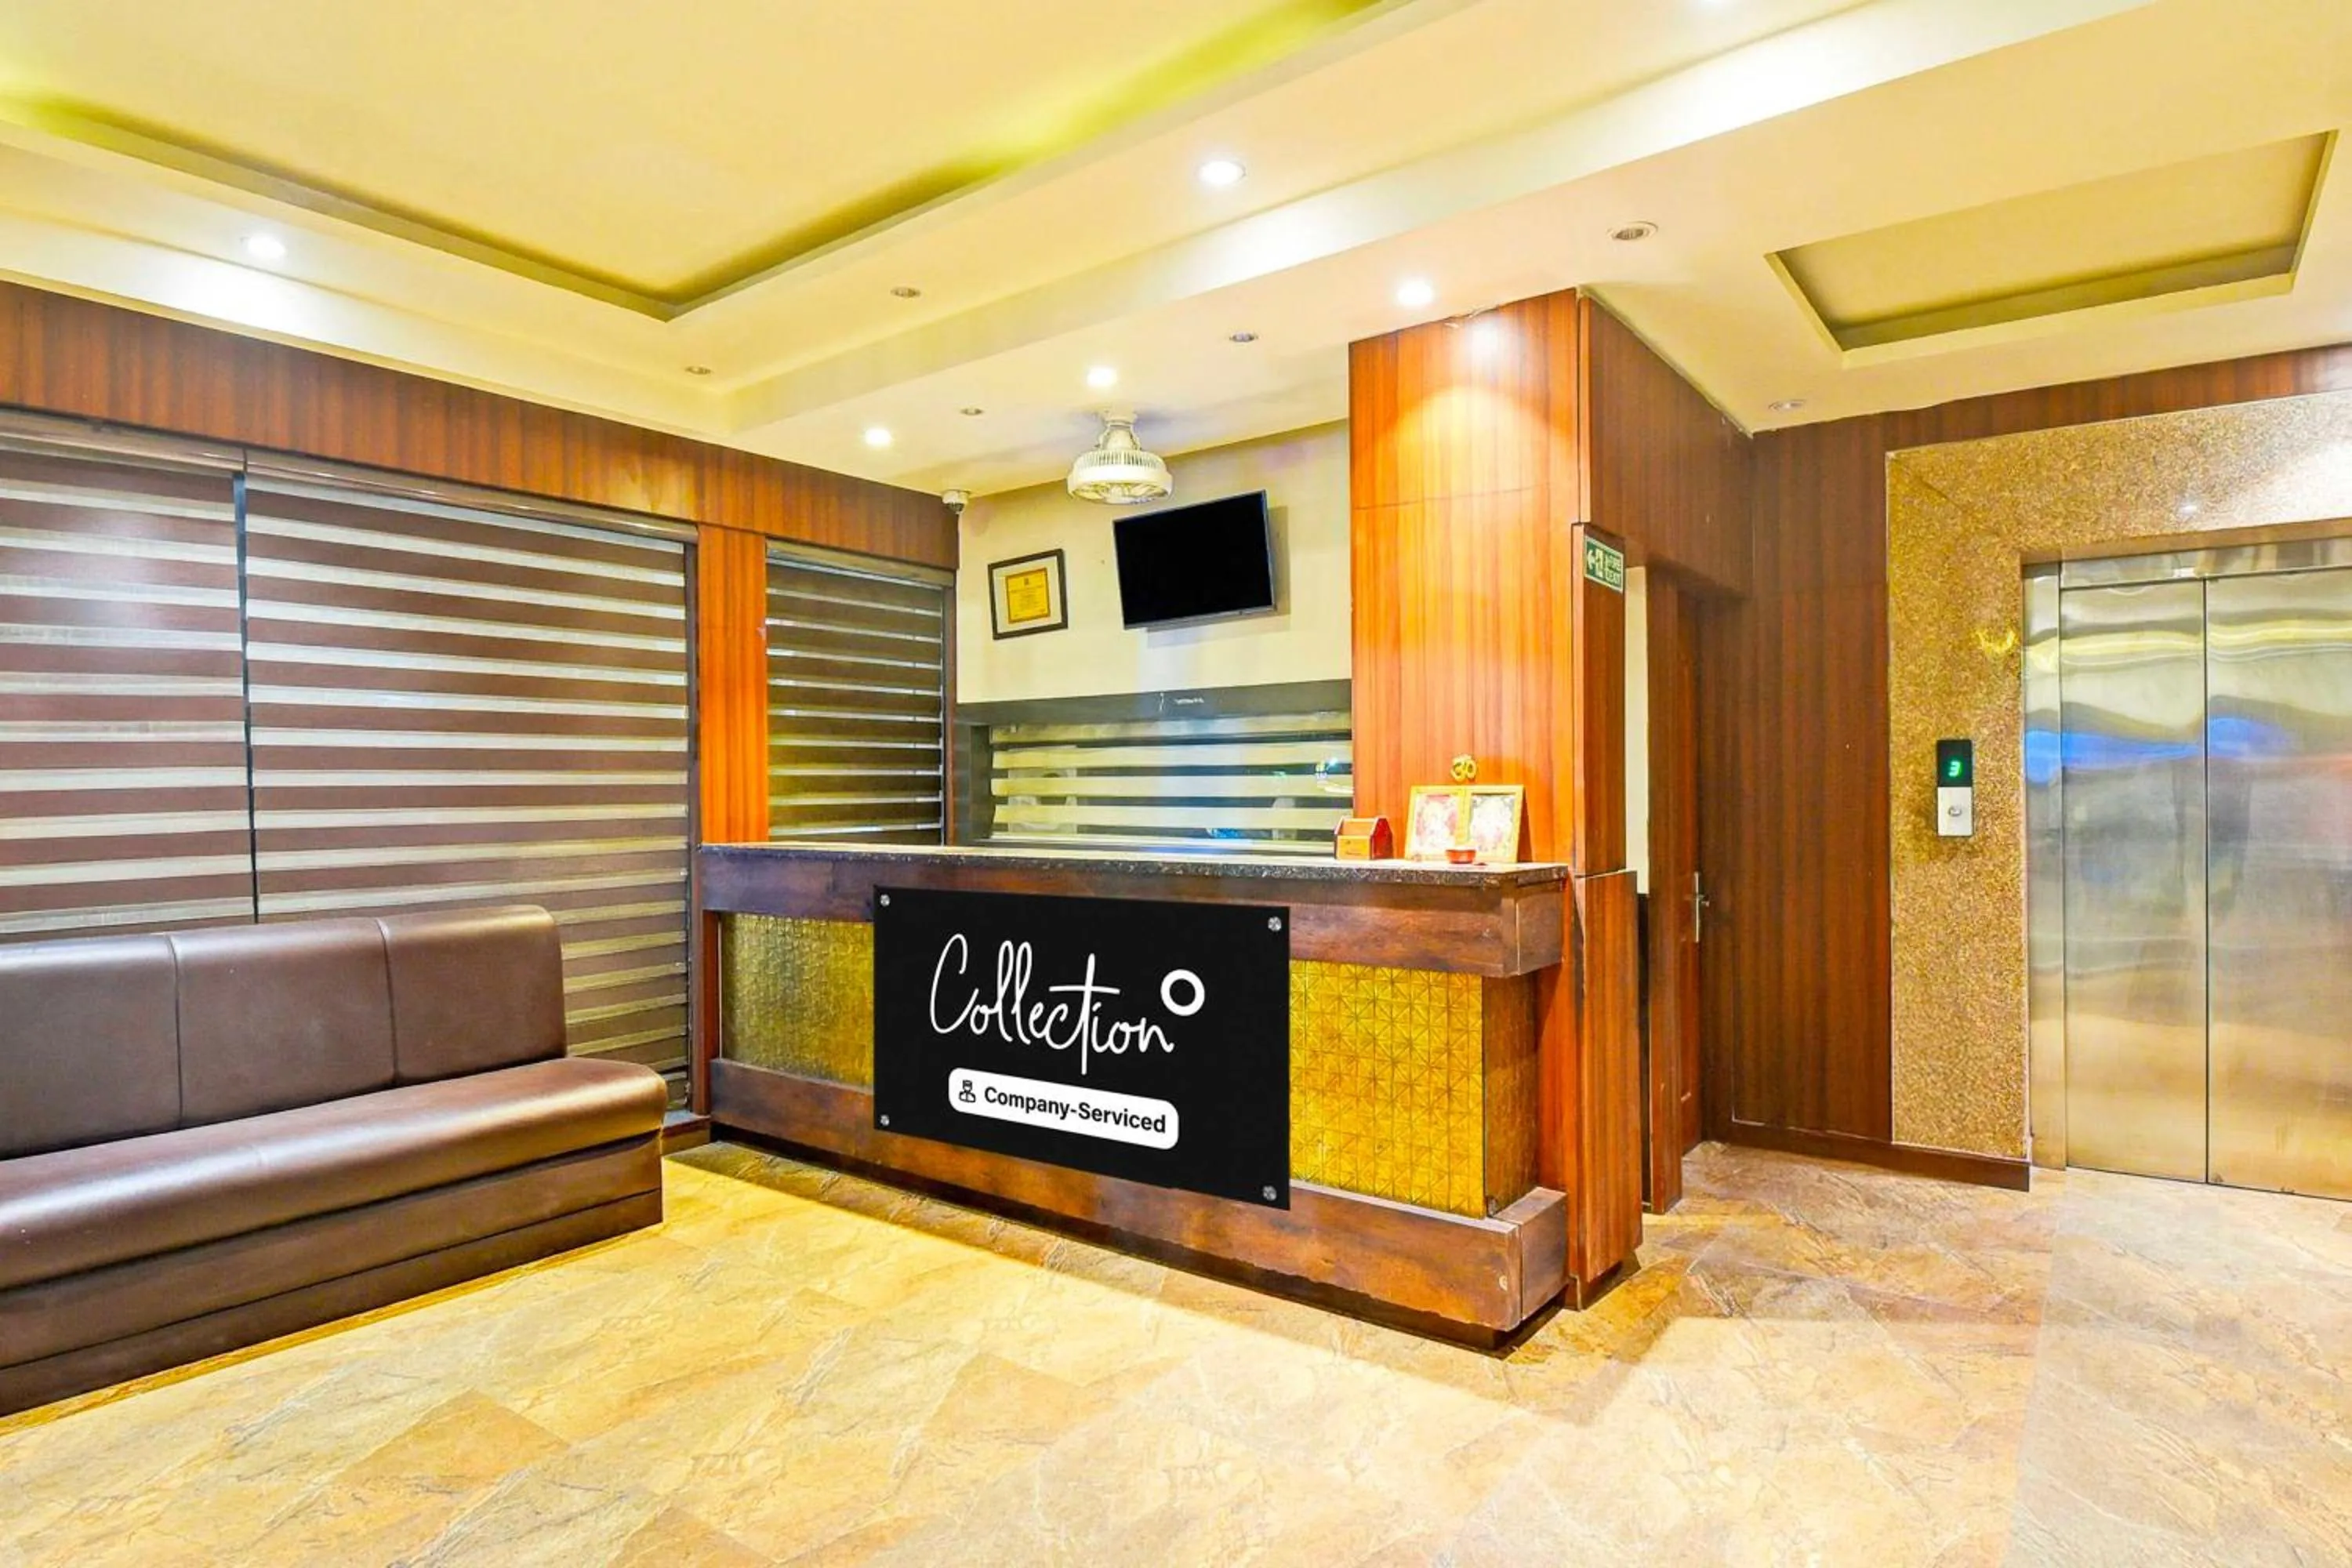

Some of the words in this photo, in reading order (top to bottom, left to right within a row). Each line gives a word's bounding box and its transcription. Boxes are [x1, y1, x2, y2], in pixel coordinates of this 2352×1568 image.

[1948, 760, 1962, 777] 3
[930, 933, 1174, 1075] Collection
[984, 1086, 1166, 1134] Company-Serviced
